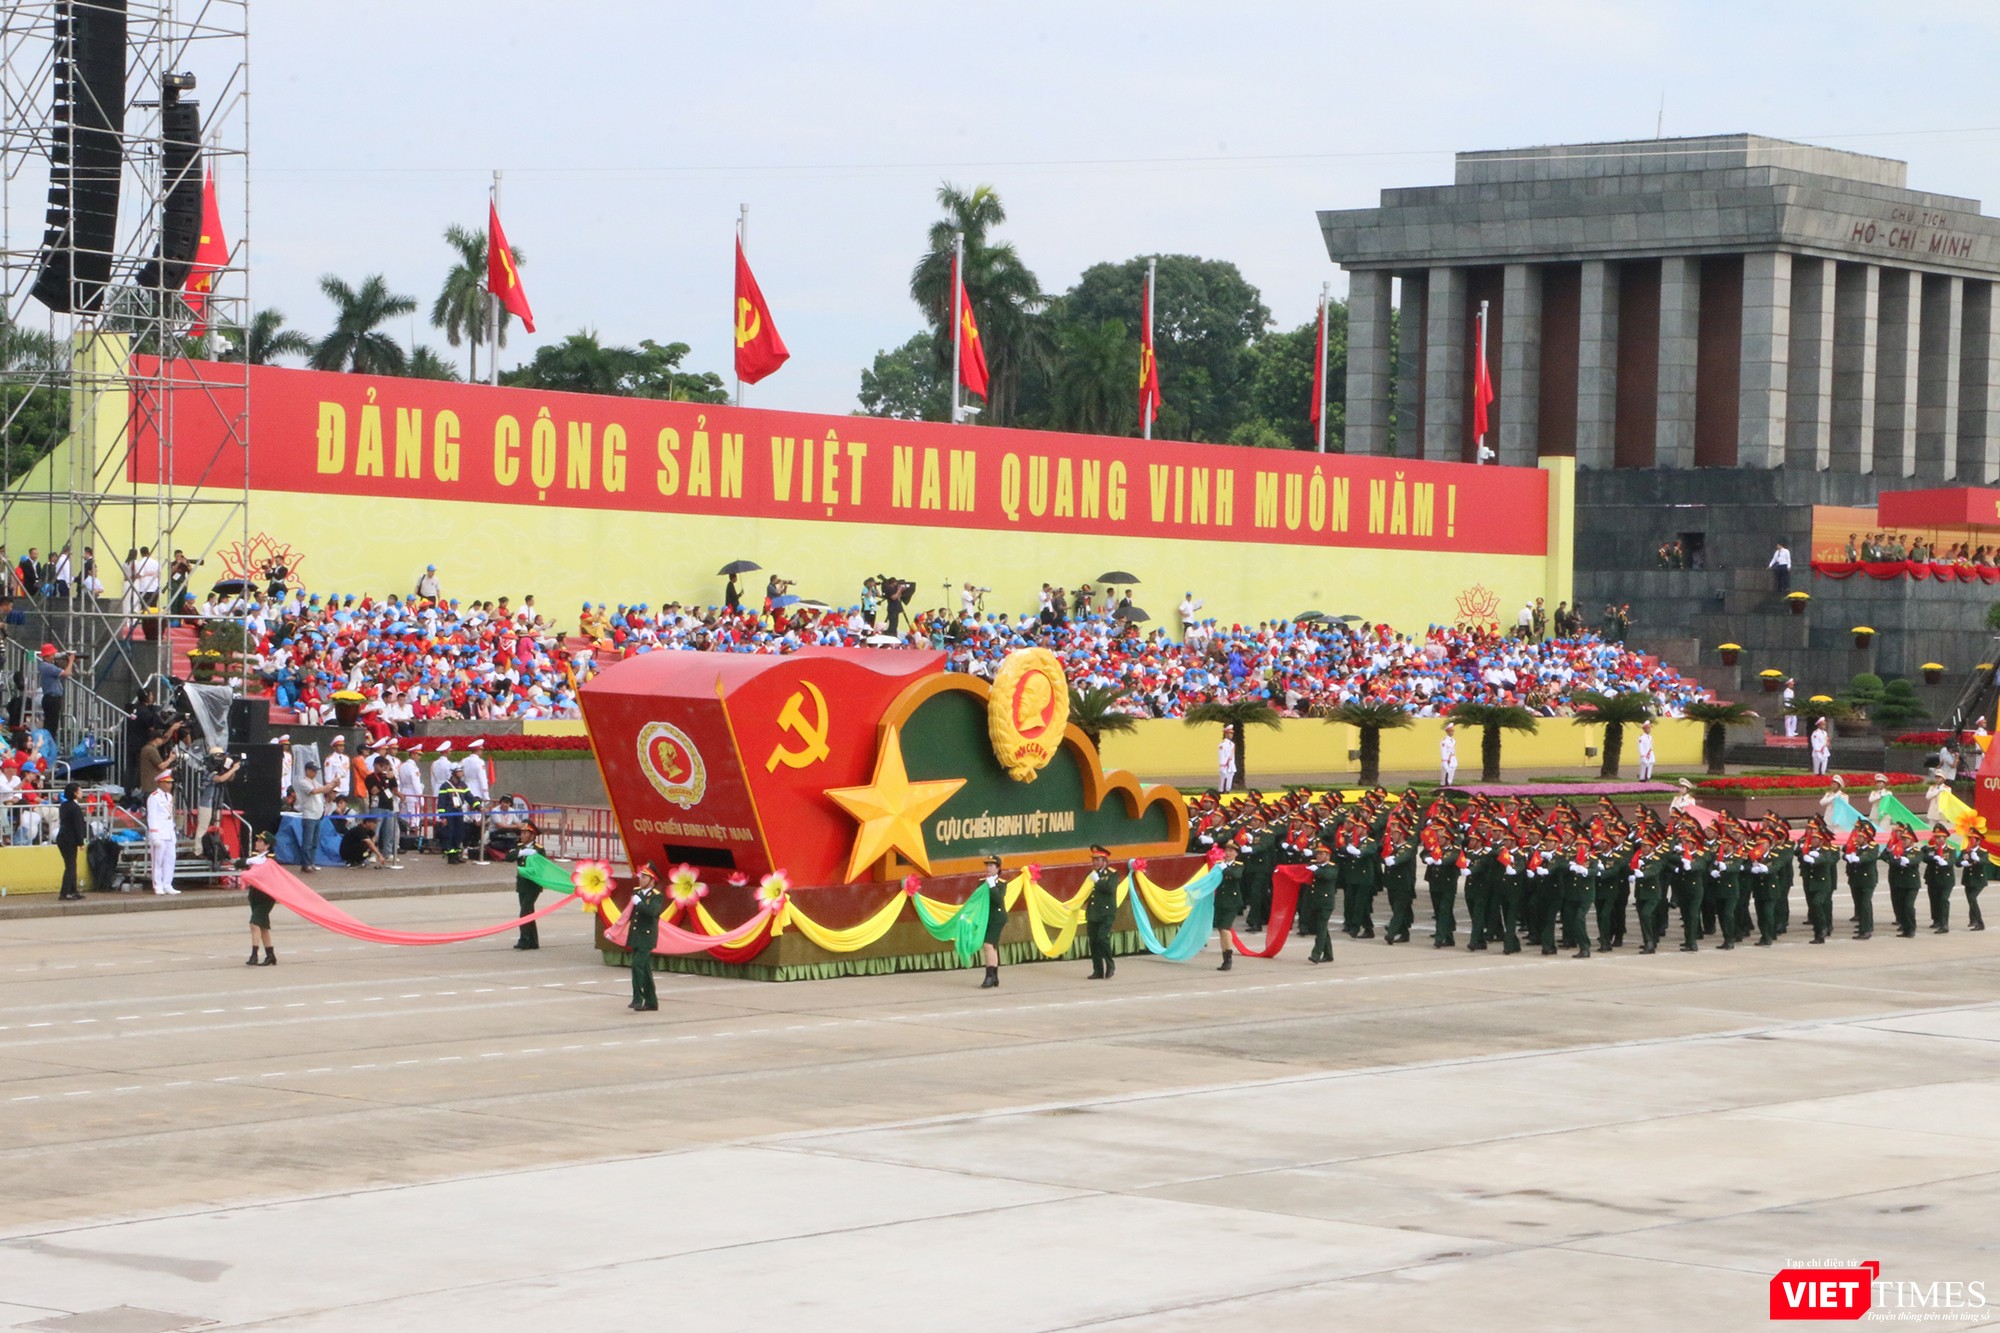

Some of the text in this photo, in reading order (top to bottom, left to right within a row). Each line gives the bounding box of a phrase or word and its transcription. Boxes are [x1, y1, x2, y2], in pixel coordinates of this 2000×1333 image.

[316, 386, 461, 482] ĐẢNG
[494, 406, 627, 501] CỘNG
[657, 414, 744, 499] SẢN
[771, 429, 867, 516] VIỆT
[892, 445, 976, 512] NAM
[1001, 453, 1127, 521] QUANG
[1149, 464, 1234, 526] VINH
[1255, 465, 1350, 532] MUÔN
[728, 827, 754, 841] NAM
[936, 809, 1075, 846] CỰU CHIẾN BINH VIỆT NAM
